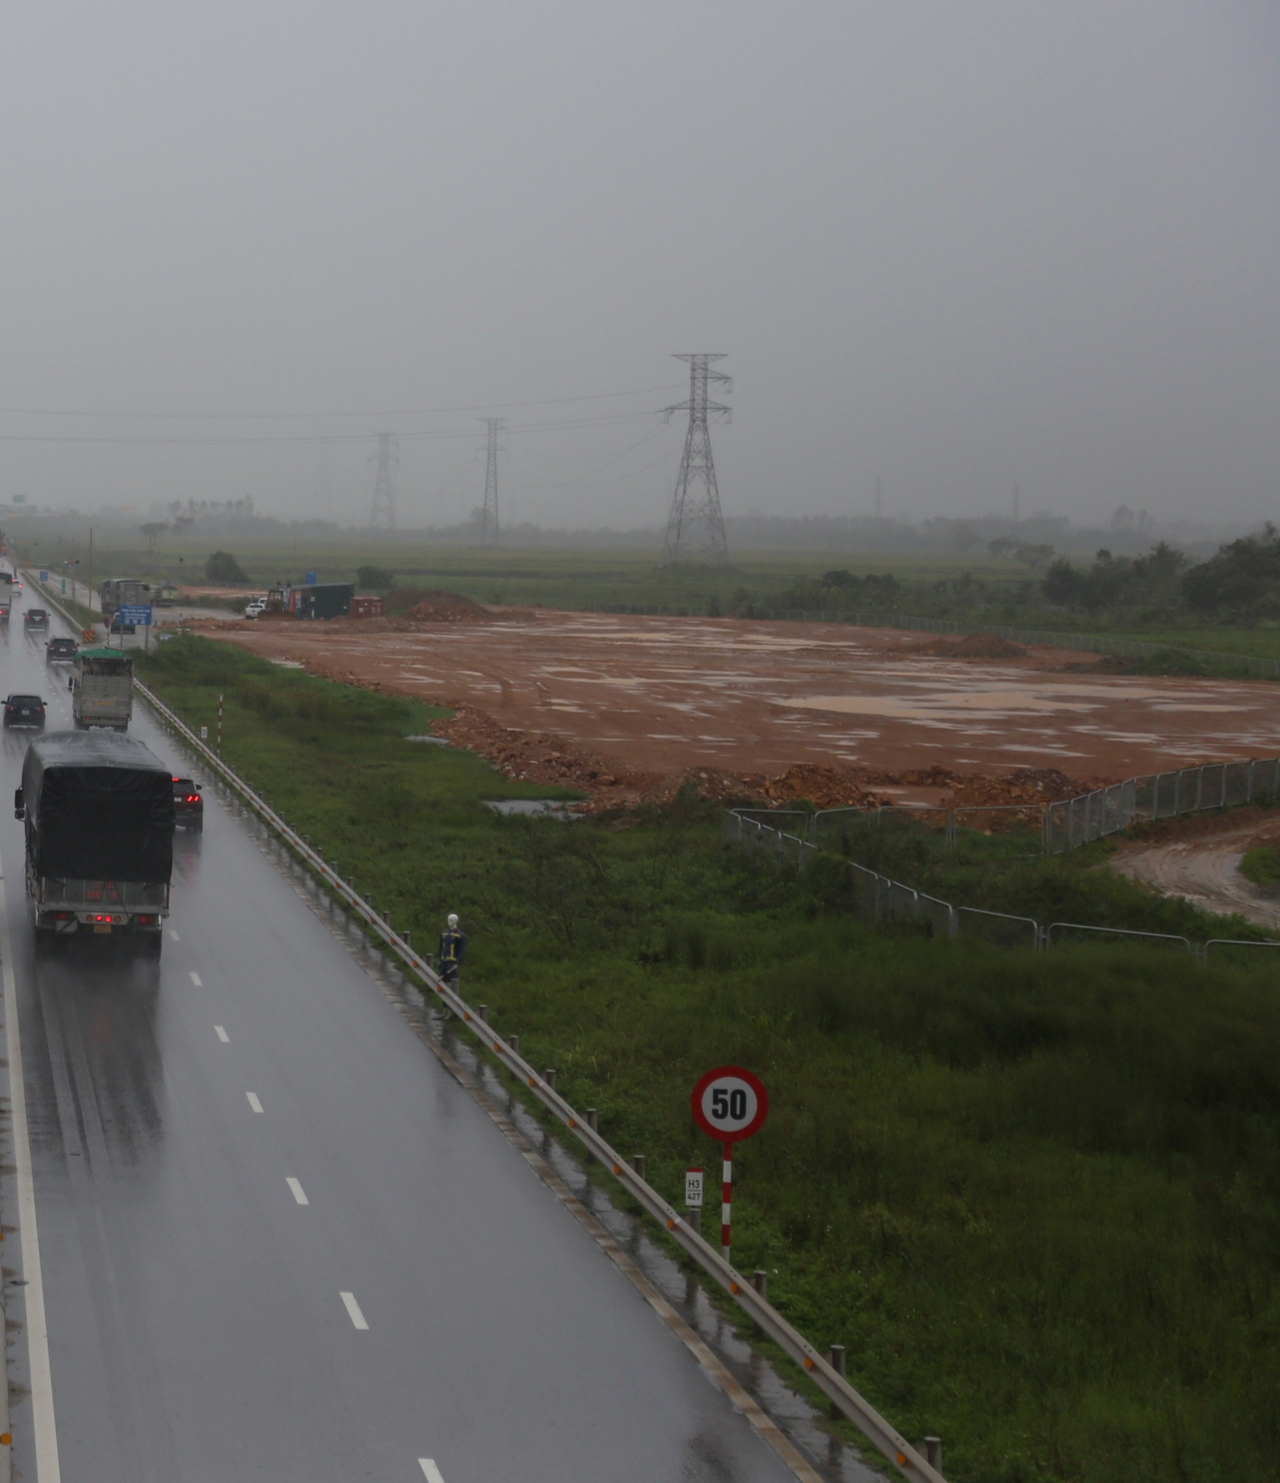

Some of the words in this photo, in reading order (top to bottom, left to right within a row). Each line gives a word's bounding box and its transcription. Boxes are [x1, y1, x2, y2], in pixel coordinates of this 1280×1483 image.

[712, 1089, 746, 1121] 50
[688, 1179, 700, 1189] H3
[687, 1192, 701, 1201] 427
